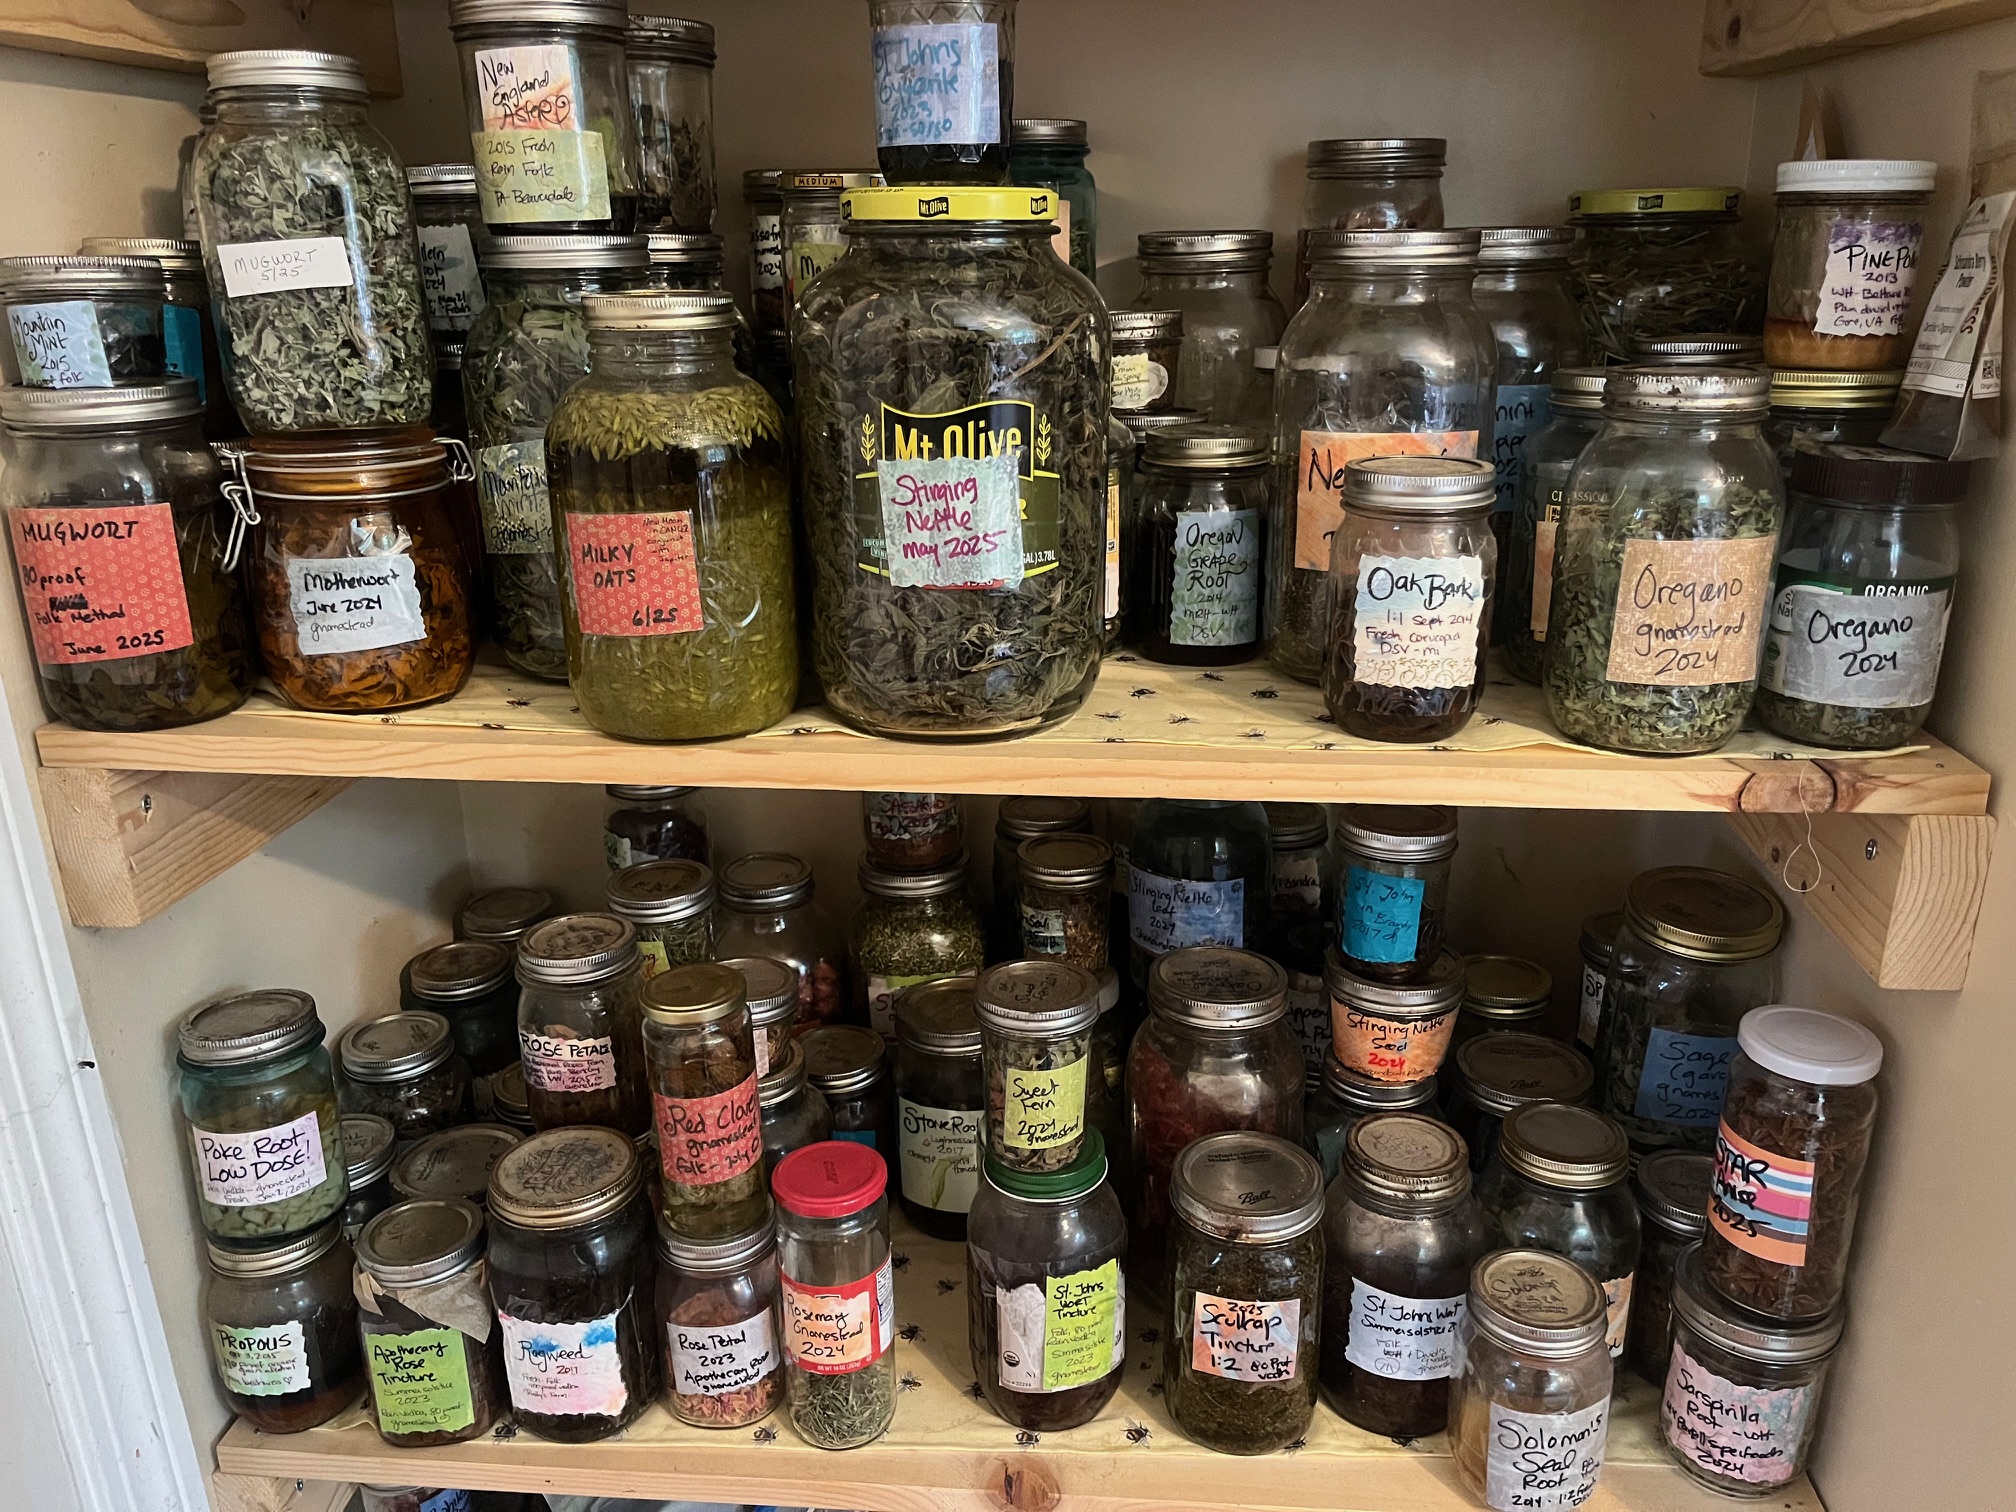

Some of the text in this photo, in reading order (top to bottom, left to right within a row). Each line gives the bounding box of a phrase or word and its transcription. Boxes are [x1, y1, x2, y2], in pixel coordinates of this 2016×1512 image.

[481, 57, 514, 91] New
[235, 249, 317, 273] MUGWORT
[1834, 245, 1894, 272] PINE
[261, 265, 302, 282] 5/25
[1862, 272, 1897, 283] 2013
[41, 355, 71, 372] 2015
[943, 420, 1021, 460] Olive
[891, 474, 979, 508] Stinging
[906, 506, 973, 533] Nettle
[21, 520, 138, 546] MUGWORT
[582, 543, 635, 564] MILKY
[943, 530, 1008, 559] 2025
[40, 567, 86, 590] proof
[593, 568, 636, 588] OATS
[1367, 567, 1474, 611] Oak Bark
[1633, 563, 1743, 622] Oregano
[35, 604, 126, 625] Folk Method
[306, 595, 382, 615] June 2024
[632, 605, 678, 627] 6/25
[1412, 615, 1443, 630] Sept
[1808, 609, 1913, 653] Oregano
[62, 630, 164, 655] June 2025
[1380, 641, 1409, 655] DSV
[1654, 649, 1718, 676] 2024
[1838, 651, 1898, 677] 2024
[1346, 1012, 1409, 1040] Stinging
[520, 1033, 563, 1057] ROSE
[1368, 1052, 1406, 1070] 2024
[1660, 1042, 1730, 1070] Sage
[1013, 1077, 1059, 1098] Sweet
[1020, 1096, 1055, 1114] Fern
[664, 1105, 706, 1137] Red
[1018, 1119, 1055, 1136] 2024
[201, 1128, 305, 1160] Poke Root
[1238, 1190, 1277, 1205] Ball
[1053, 1281, 1104, 1299] St. Johns
[1053, 1305, 1097, 1319] Tincture
[1227, 1302, 1270, 1316] 2025
[1363, 1295, 1387, 1315] St
[678, 1329, 747, 1351] Rose Petal
[800, 1341, 846, 1358] 2024
[391, 1356, 425, 1372] Rose
[514, 1340, 594, 1373] Ragweed
[699, 1352, 736, 1367] 2023
[1066, 1353, 1094, 1367] 2023
[1211, 1354, 1242, 1371] 1:2
[377, 1372, 438, 1385] Tincture
[394, 1394, 431, 1405] 2023
[1686, 1400, 1723, 1429] Root
[1498, 1413, 1603, 1450] Solomon's
[1513, 1449, 1577, 1473] Seal
[1522, 1473, 1569, 1490] Root
